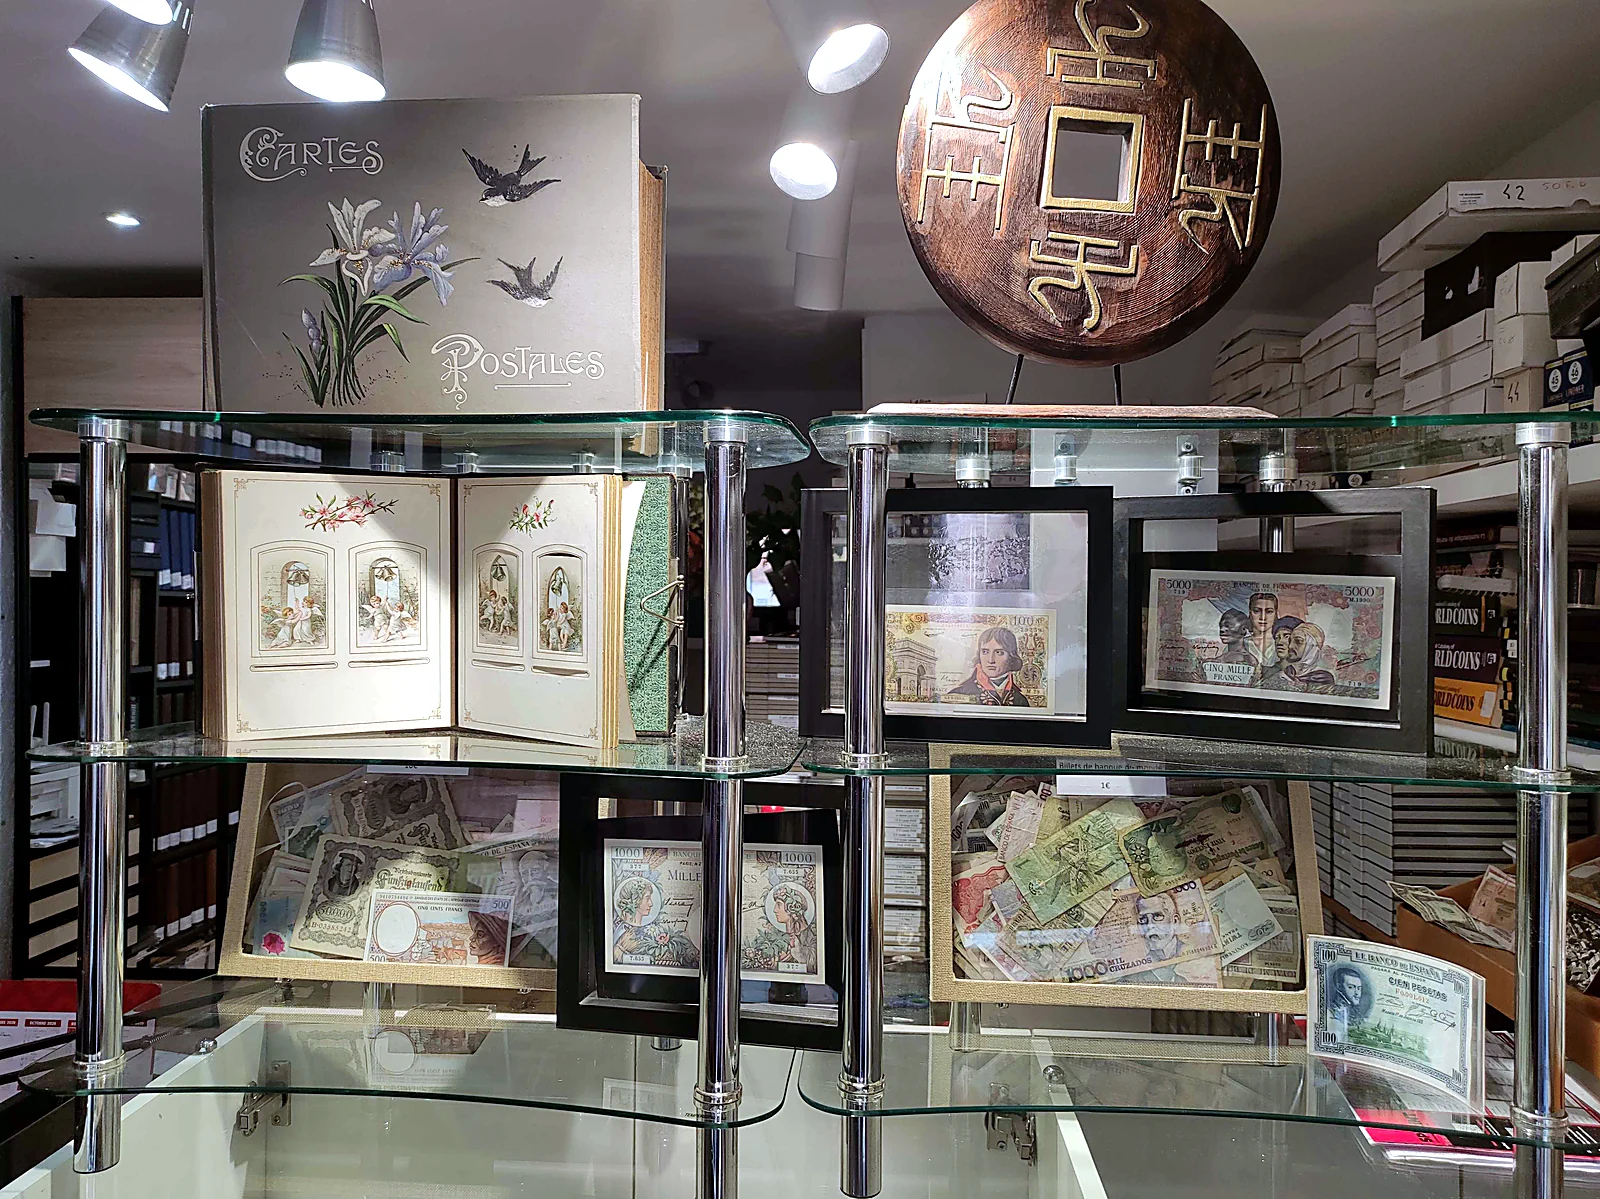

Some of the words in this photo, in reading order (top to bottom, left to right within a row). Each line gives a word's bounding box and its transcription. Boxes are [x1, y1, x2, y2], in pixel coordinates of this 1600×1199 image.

[431, 334, 605, 410] POSTALES
[1166, 580, 1191, 590] 5000
[1344, 587, 1374, 597] 5000
[1452, 607, 1479, 626] COINS
[1452, 651, 1481, 671] COINS
[1204, 664, 1224, 674] CINQ
[1226, 665, 1252, 675] MILLE
[1213, 673, 1242, 682] FRANCS
[1451, 692, 1476, 712] COINS
[615, 848, 640, 858] 1000
[785, 852, 812, 863] 1000
[493, 901, 509, 910] 500
[1107, 957, 1126, 967] MIL
[1321, 949, 1337, 962] 100
[1367, 953, 1399, 967] BANCO
[1109, 957, 1153, 973] CRUZADOS
[1388, 977, 1410, 991] CIEN
[1411, 981, 1448, 1002] PESETAS
[1453, 979, 1465, 995] 100
[1322, 1031, 1337, 1044] 100
[1451, 1068, 1463, 1084] 100
